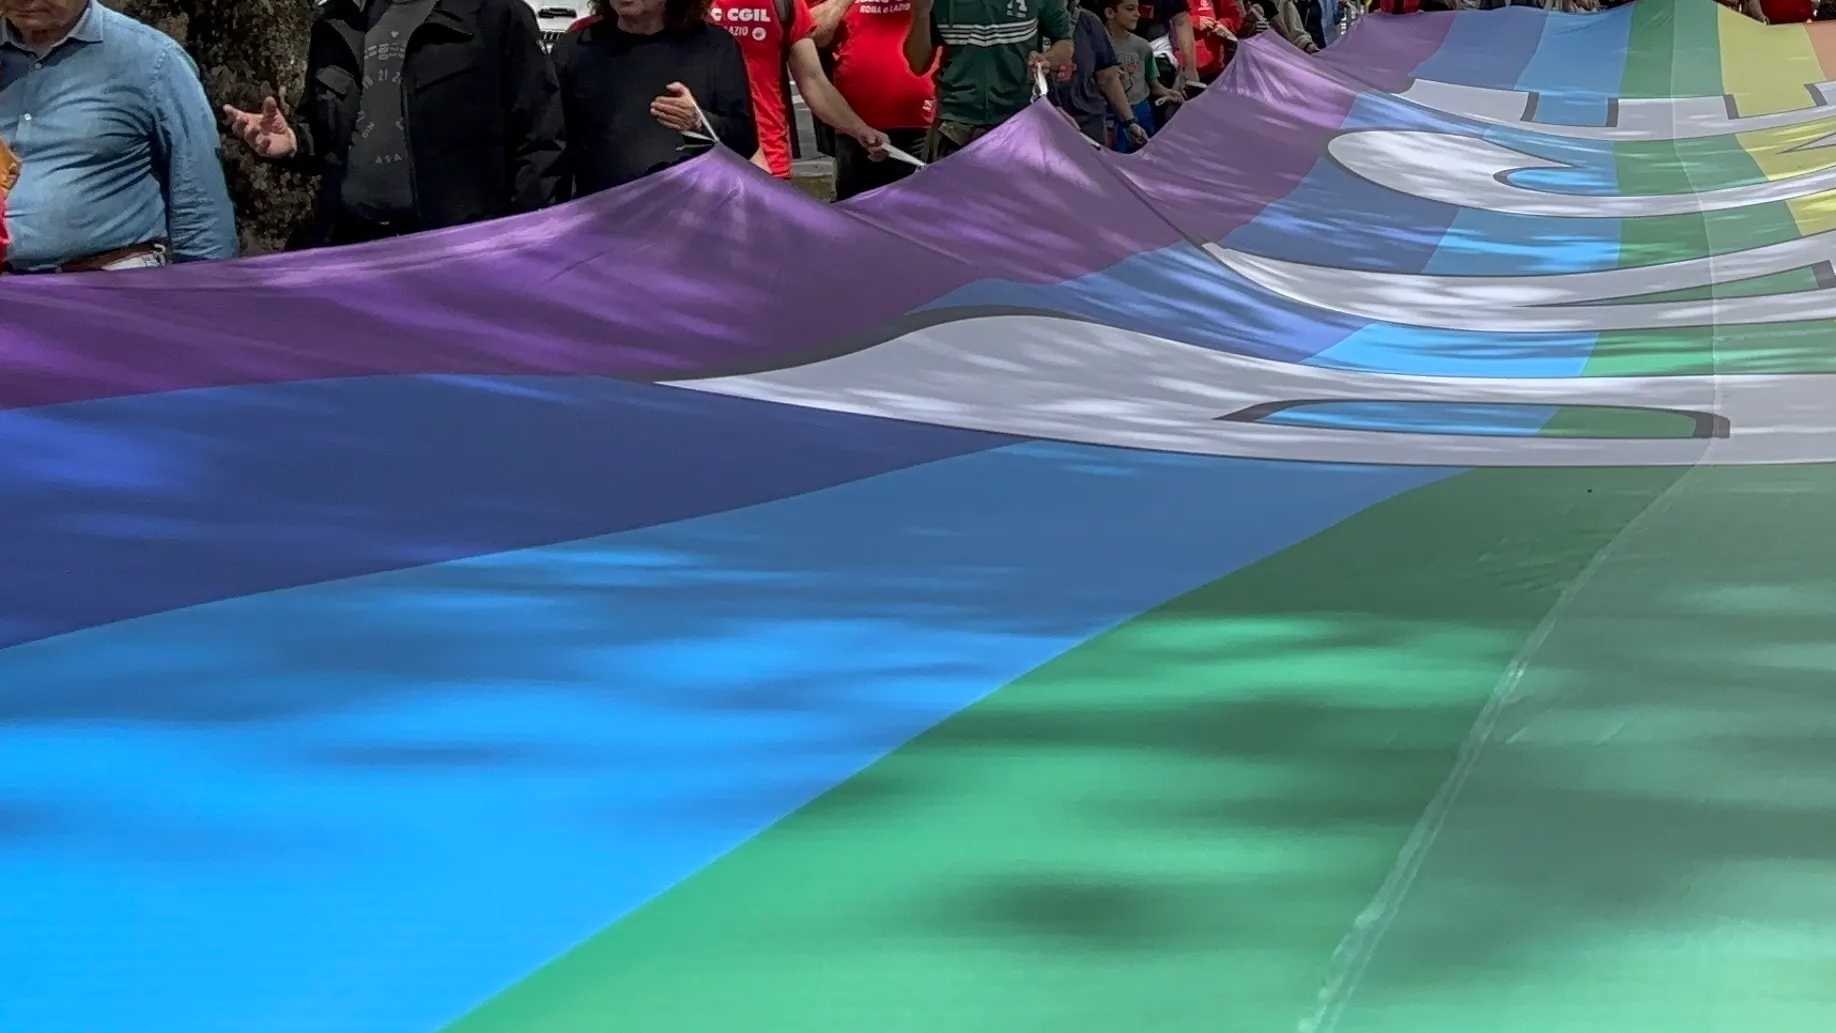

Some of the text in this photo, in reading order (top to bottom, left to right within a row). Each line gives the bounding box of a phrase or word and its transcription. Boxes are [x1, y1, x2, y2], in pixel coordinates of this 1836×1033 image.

[727, 7, 771, 23] CGIL
[722, 25, 749, 37] AZIO
[375, 153, 405, 165] ASA
